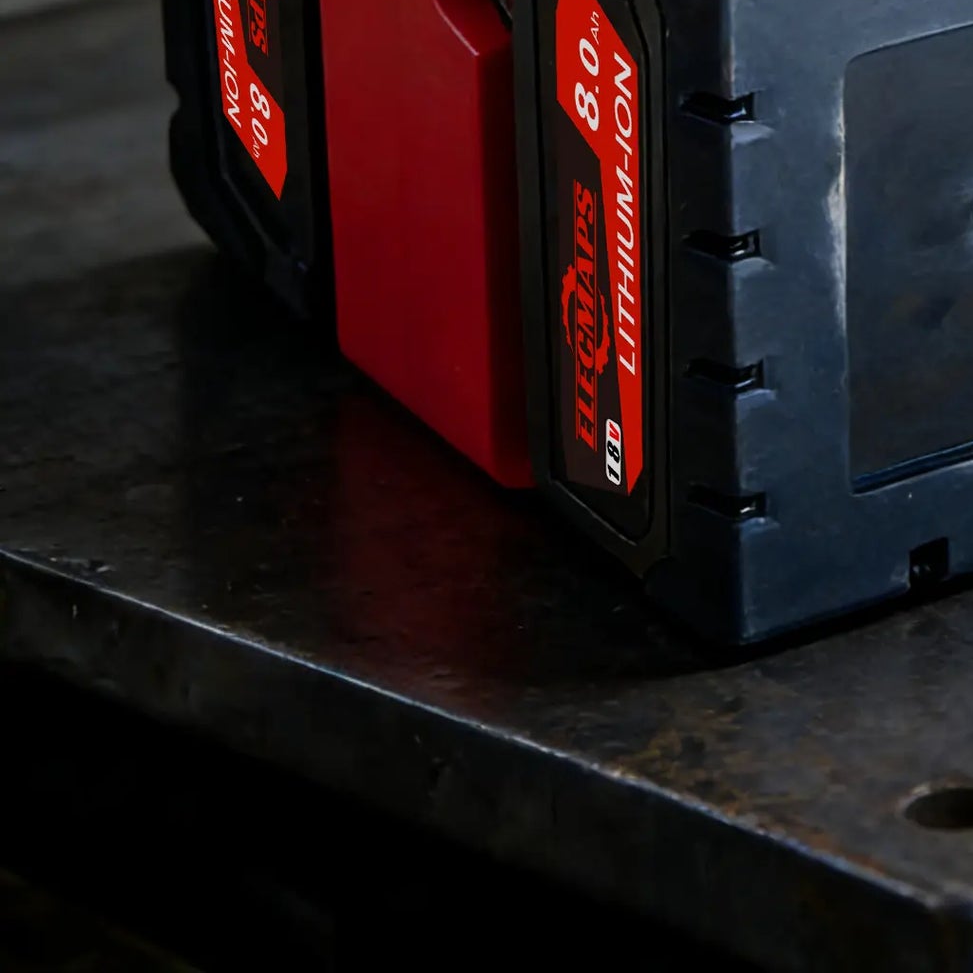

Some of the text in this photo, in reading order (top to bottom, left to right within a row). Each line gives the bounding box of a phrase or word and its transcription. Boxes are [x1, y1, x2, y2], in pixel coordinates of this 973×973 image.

[575, 180, 597, 451] ELECMAPS
[613, 51, 636, 376] LITHIUM-ION
[606, 421, 621, 478] 18V
